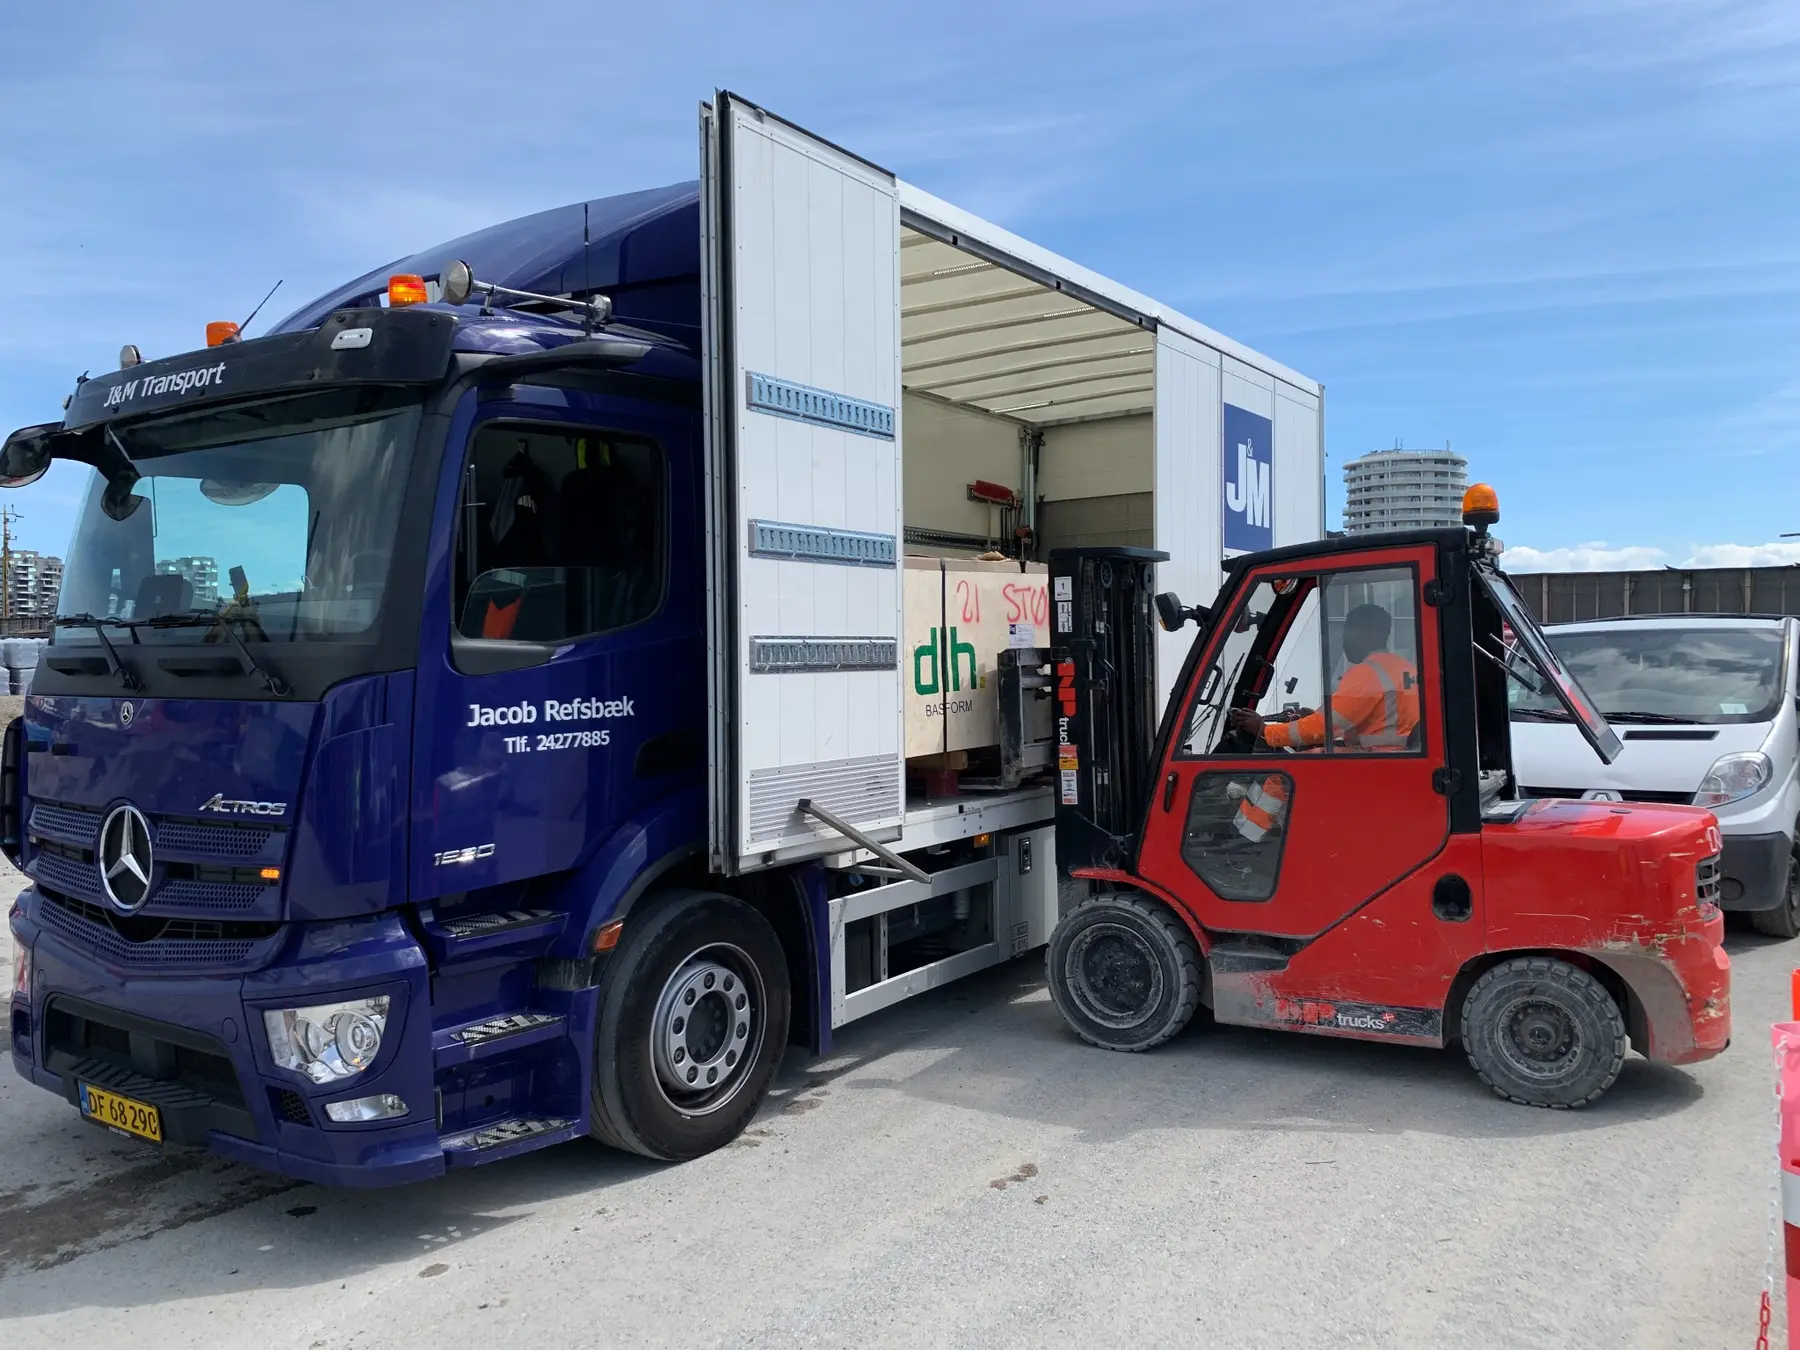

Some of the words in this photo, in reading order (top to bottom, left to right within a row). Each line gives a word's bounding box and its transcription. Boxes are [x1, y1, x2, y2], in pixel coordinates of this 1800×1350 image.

[103, 379, 139, 408] J&M
[141, 362, 227, 398] Transport
[957, 580, 980, 623] 21
[467, 701, 537, 727] Jacob
[544, 696, 635, 722] Refsbæk
[925, 700, 973, 717] BASFORM
[504, 736, 531, 753] Tlf.
[536, 730, 610, 751] 24277885
[1337, 1013, 1385, 1030] trucks
[88, 1092, 104, 1116] DF
[109, 1098, 128, 1126] 68
